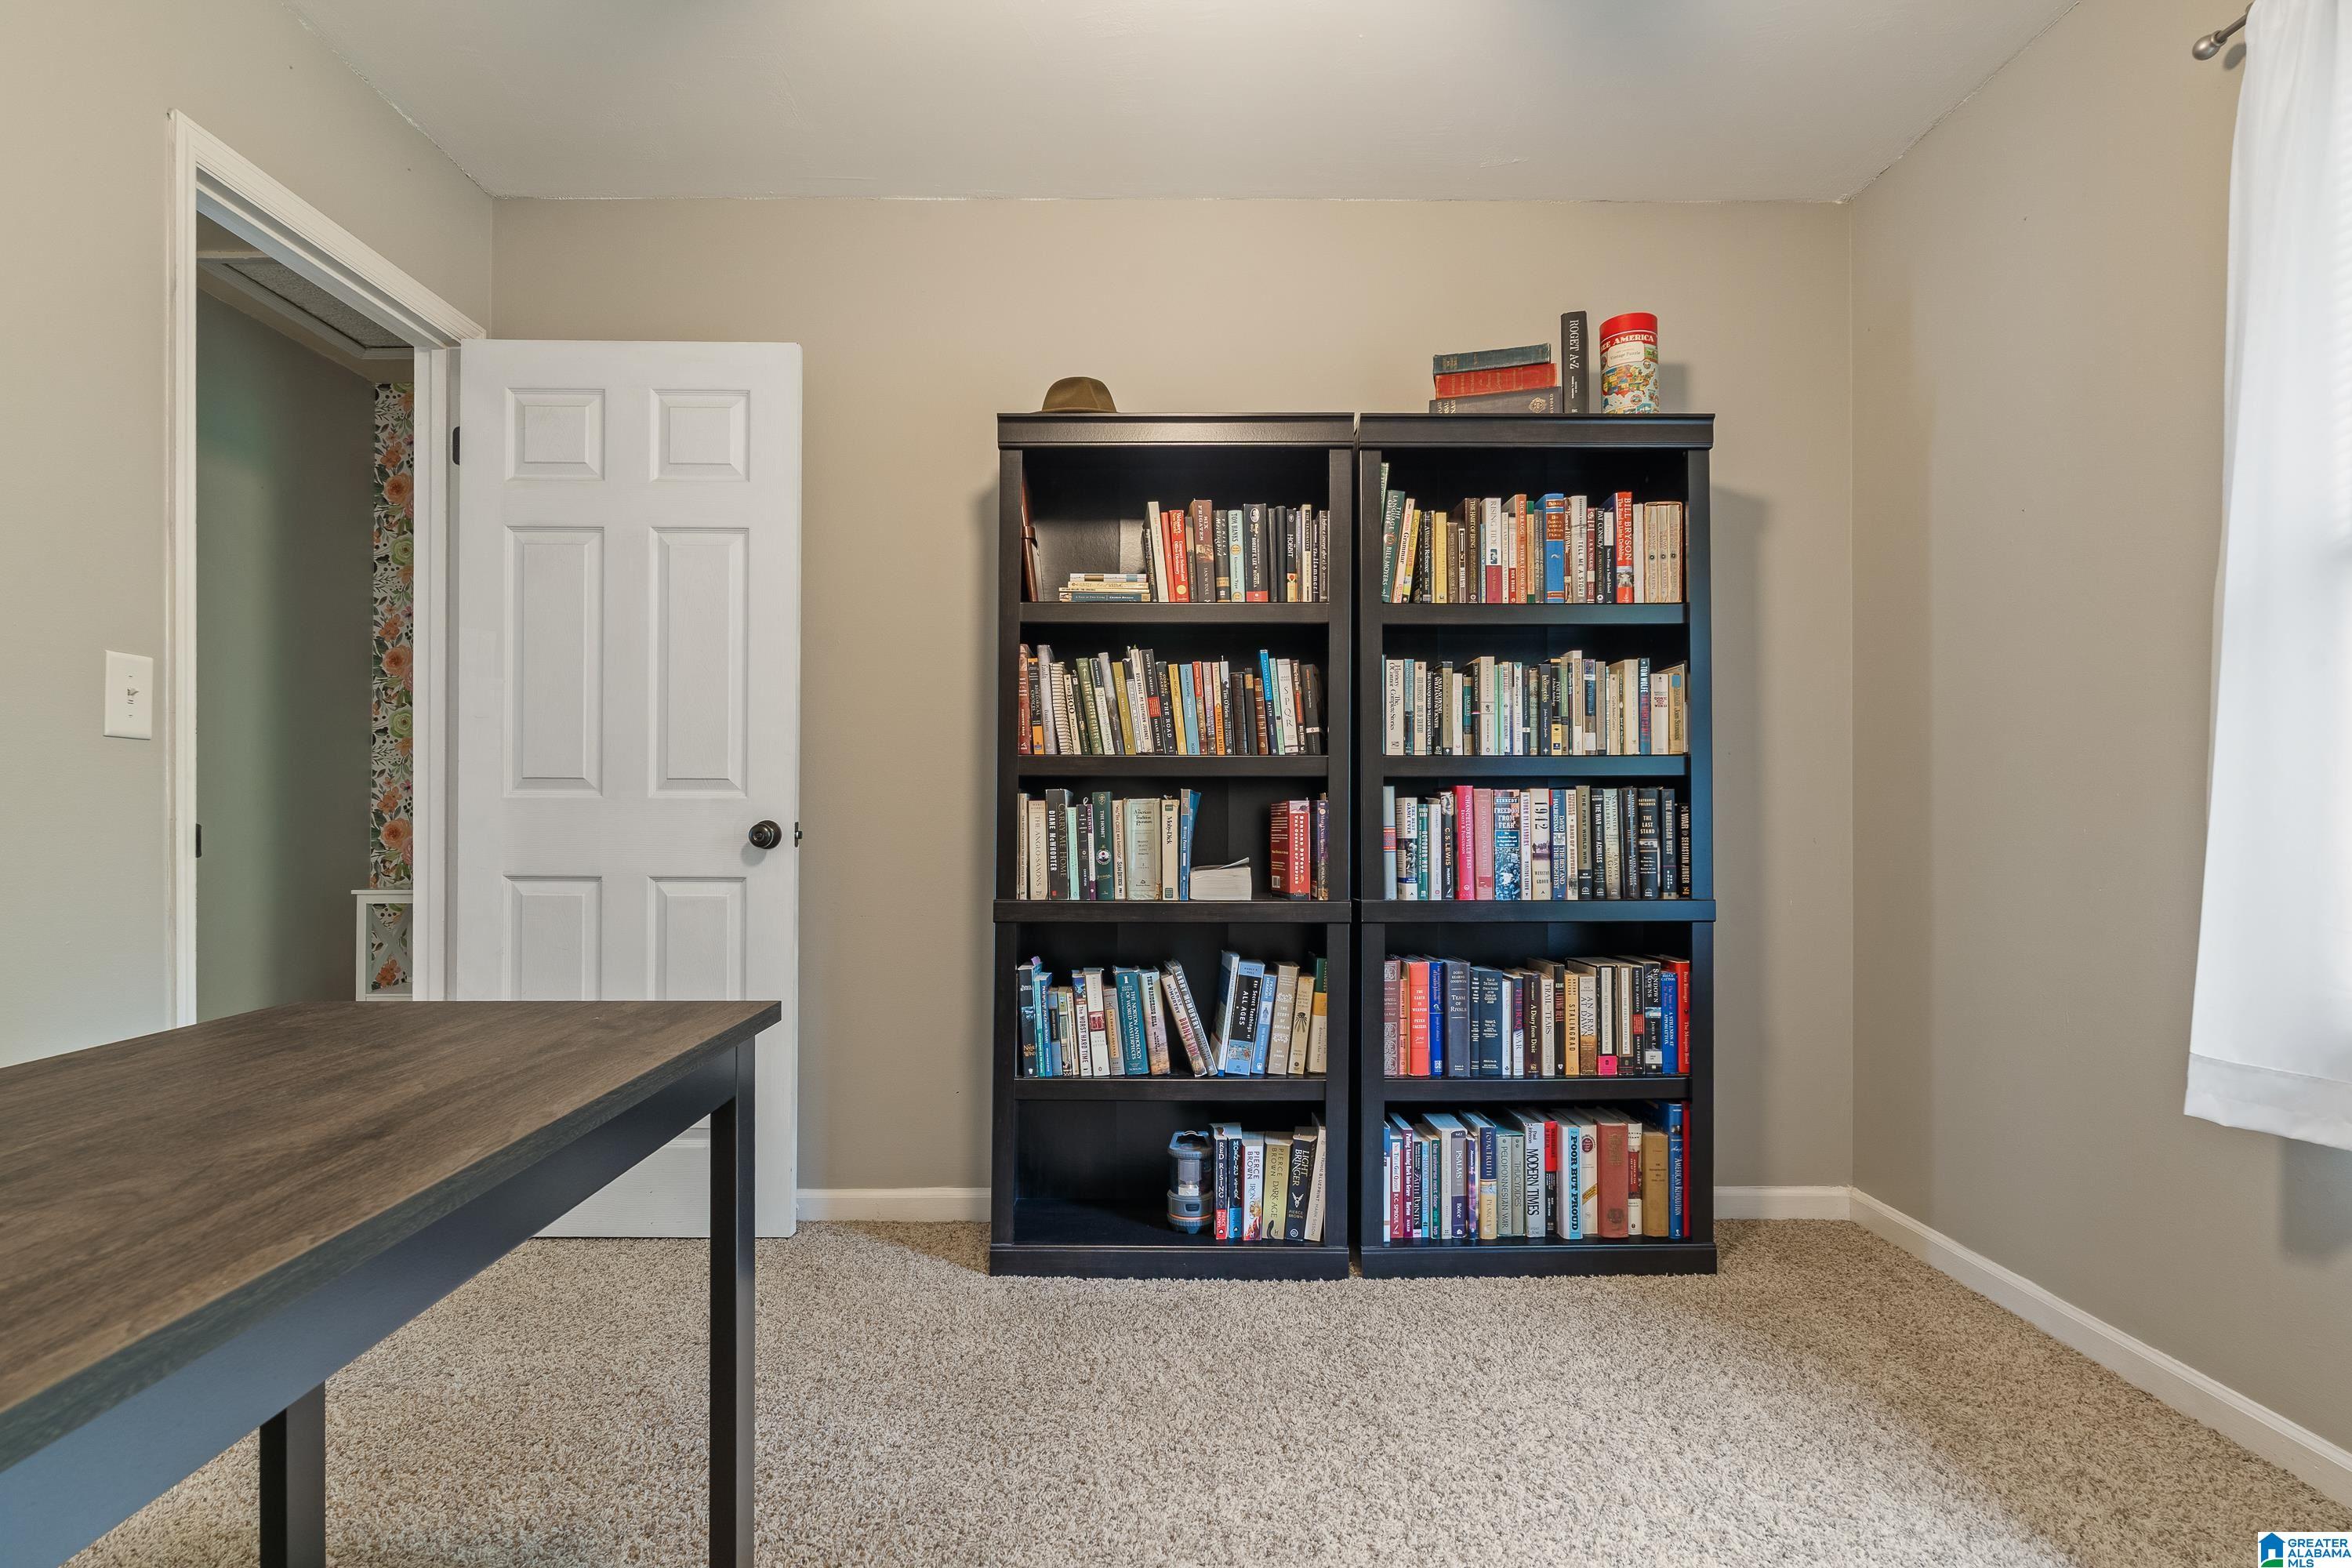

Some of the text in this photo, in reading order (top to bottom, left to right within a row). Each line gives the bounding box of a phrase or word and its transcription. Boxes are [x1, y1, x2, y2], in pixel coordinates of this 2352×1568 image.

[1570, 320, 1580, 350] ROGET
[1613, 334, 1655, 346] AMERICA
[1570, 354, 1580, 369] A-Z
[1388, 495, 1399, 529] LANGUAGE
[1399, 532, 1409, 564] Grammar
[1091, 720, 1099, 739] GABLES
[1534, 802, 1548, 829] 1942
[1058, 835, 1066, 848] ME
[1175, 971, 1186, 992] LARRY
[1126, 991, 1131, 1000] OF
[1173, 987, 1183, 1007] LARRY
[1581, 996, 1587, 1007] AT
[1587, 996, 1593, 1009] AN
[1292, 1149, 1301, 1186] BRINGER
[1301, 1150, 1309, 1177] LIGHT
[1526, 1149, 1539, 1215] MODERN TIMES
[1271, 1181, 1279, 1218] DARK AGE
